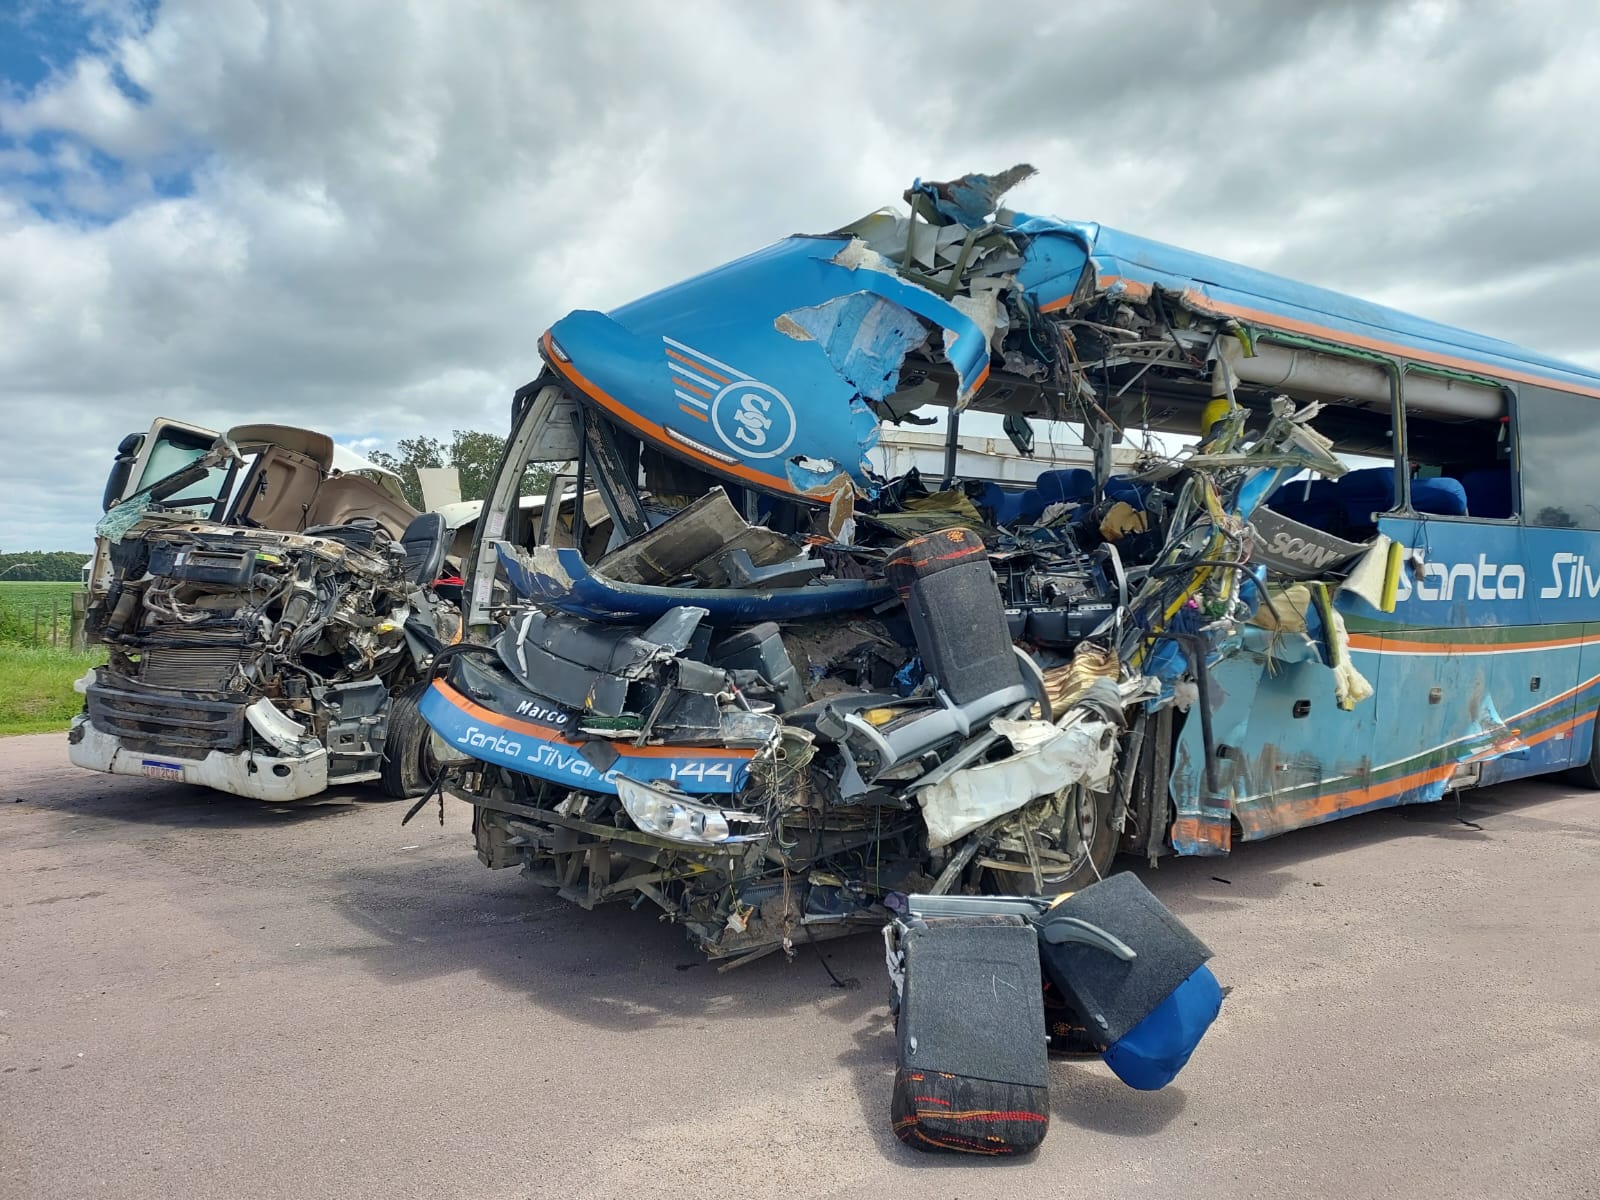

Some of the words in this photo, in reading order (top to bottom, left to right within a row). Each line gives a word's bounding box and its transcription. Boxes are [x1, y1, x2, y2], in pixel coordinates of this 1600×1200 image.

[1396, 547, 1525, 601] Santa
[516, 700, 568, 724] Marco
[457, 726, 521, 757] Santa
[670, 763, 733, 783] 144
